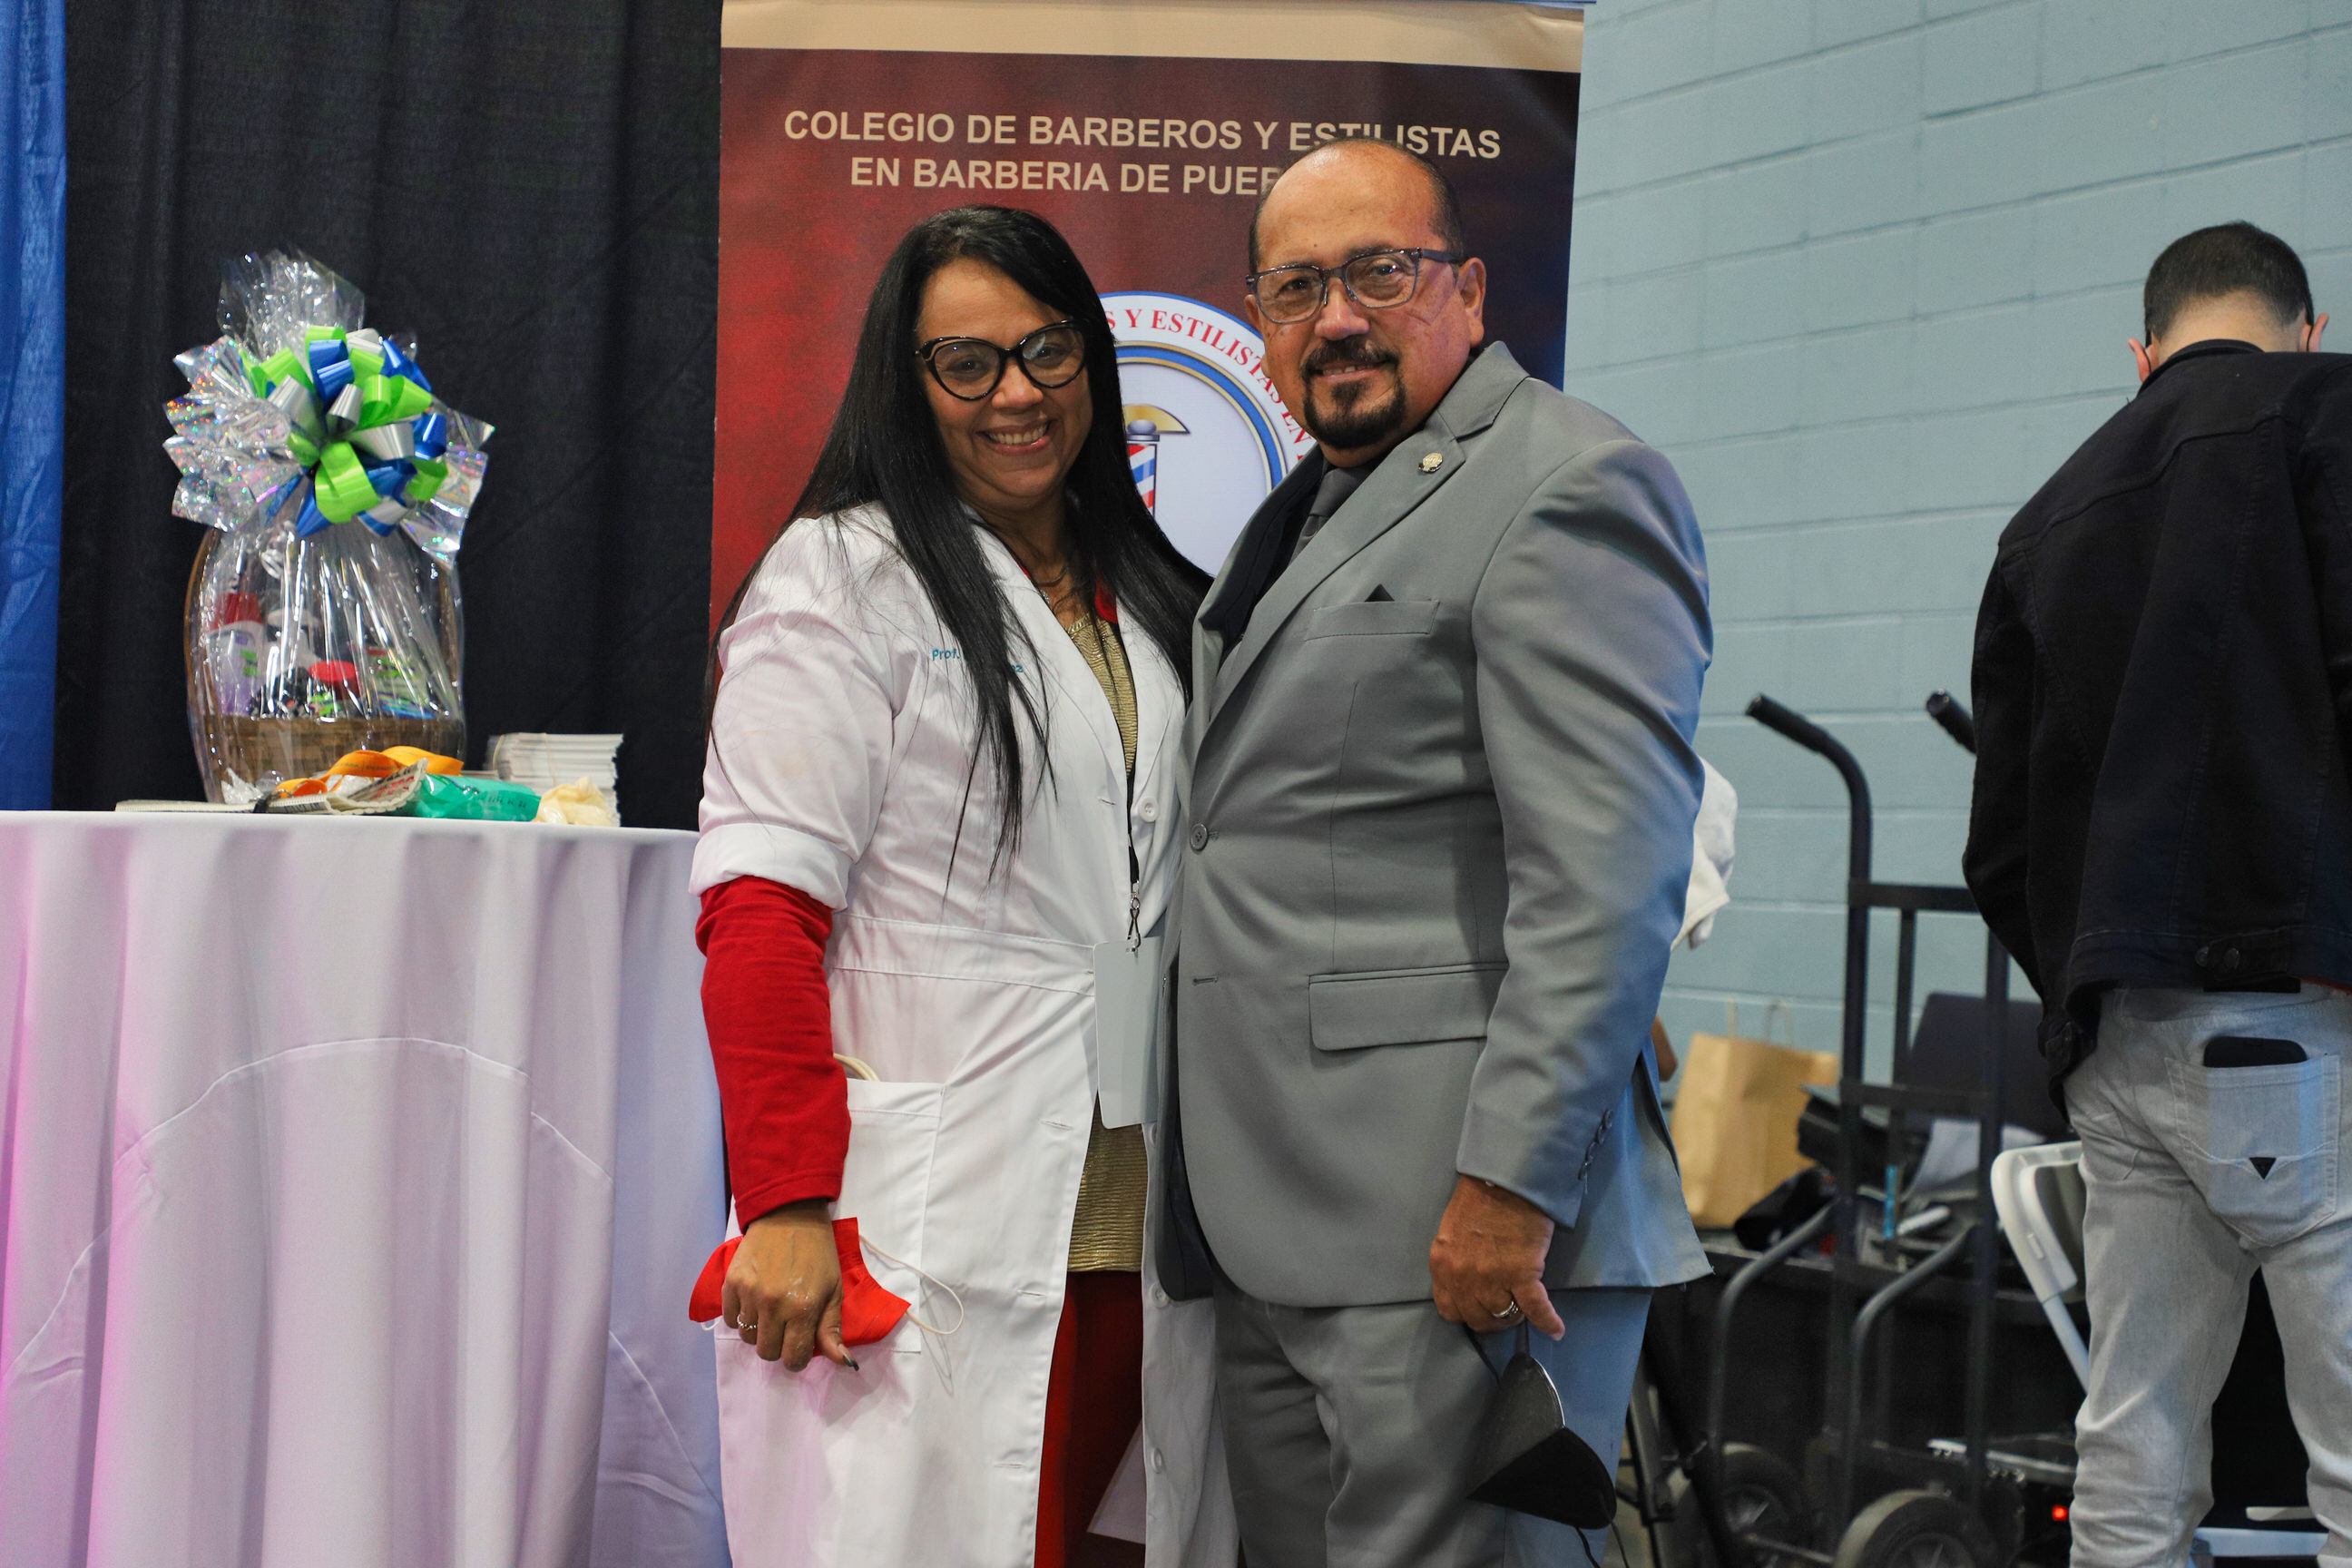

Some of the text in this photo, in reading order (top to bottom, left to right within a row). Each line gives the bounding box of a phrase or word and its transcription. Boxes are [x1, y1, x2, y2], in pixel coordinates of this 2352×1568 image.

[784, 110, 955, 143] COLEGIO
[966, 114, 1016, 144] DE
[1029, 115, 1242, 150] BARBEROS
[1253, 121, 1279, 151] Y
[851, 157, 899, 187] EN
[913, 159, 1110, 191] BARBERIA
[1120, 163, 1170, 193] DE
[1124, 309, 1142, 328] Y
